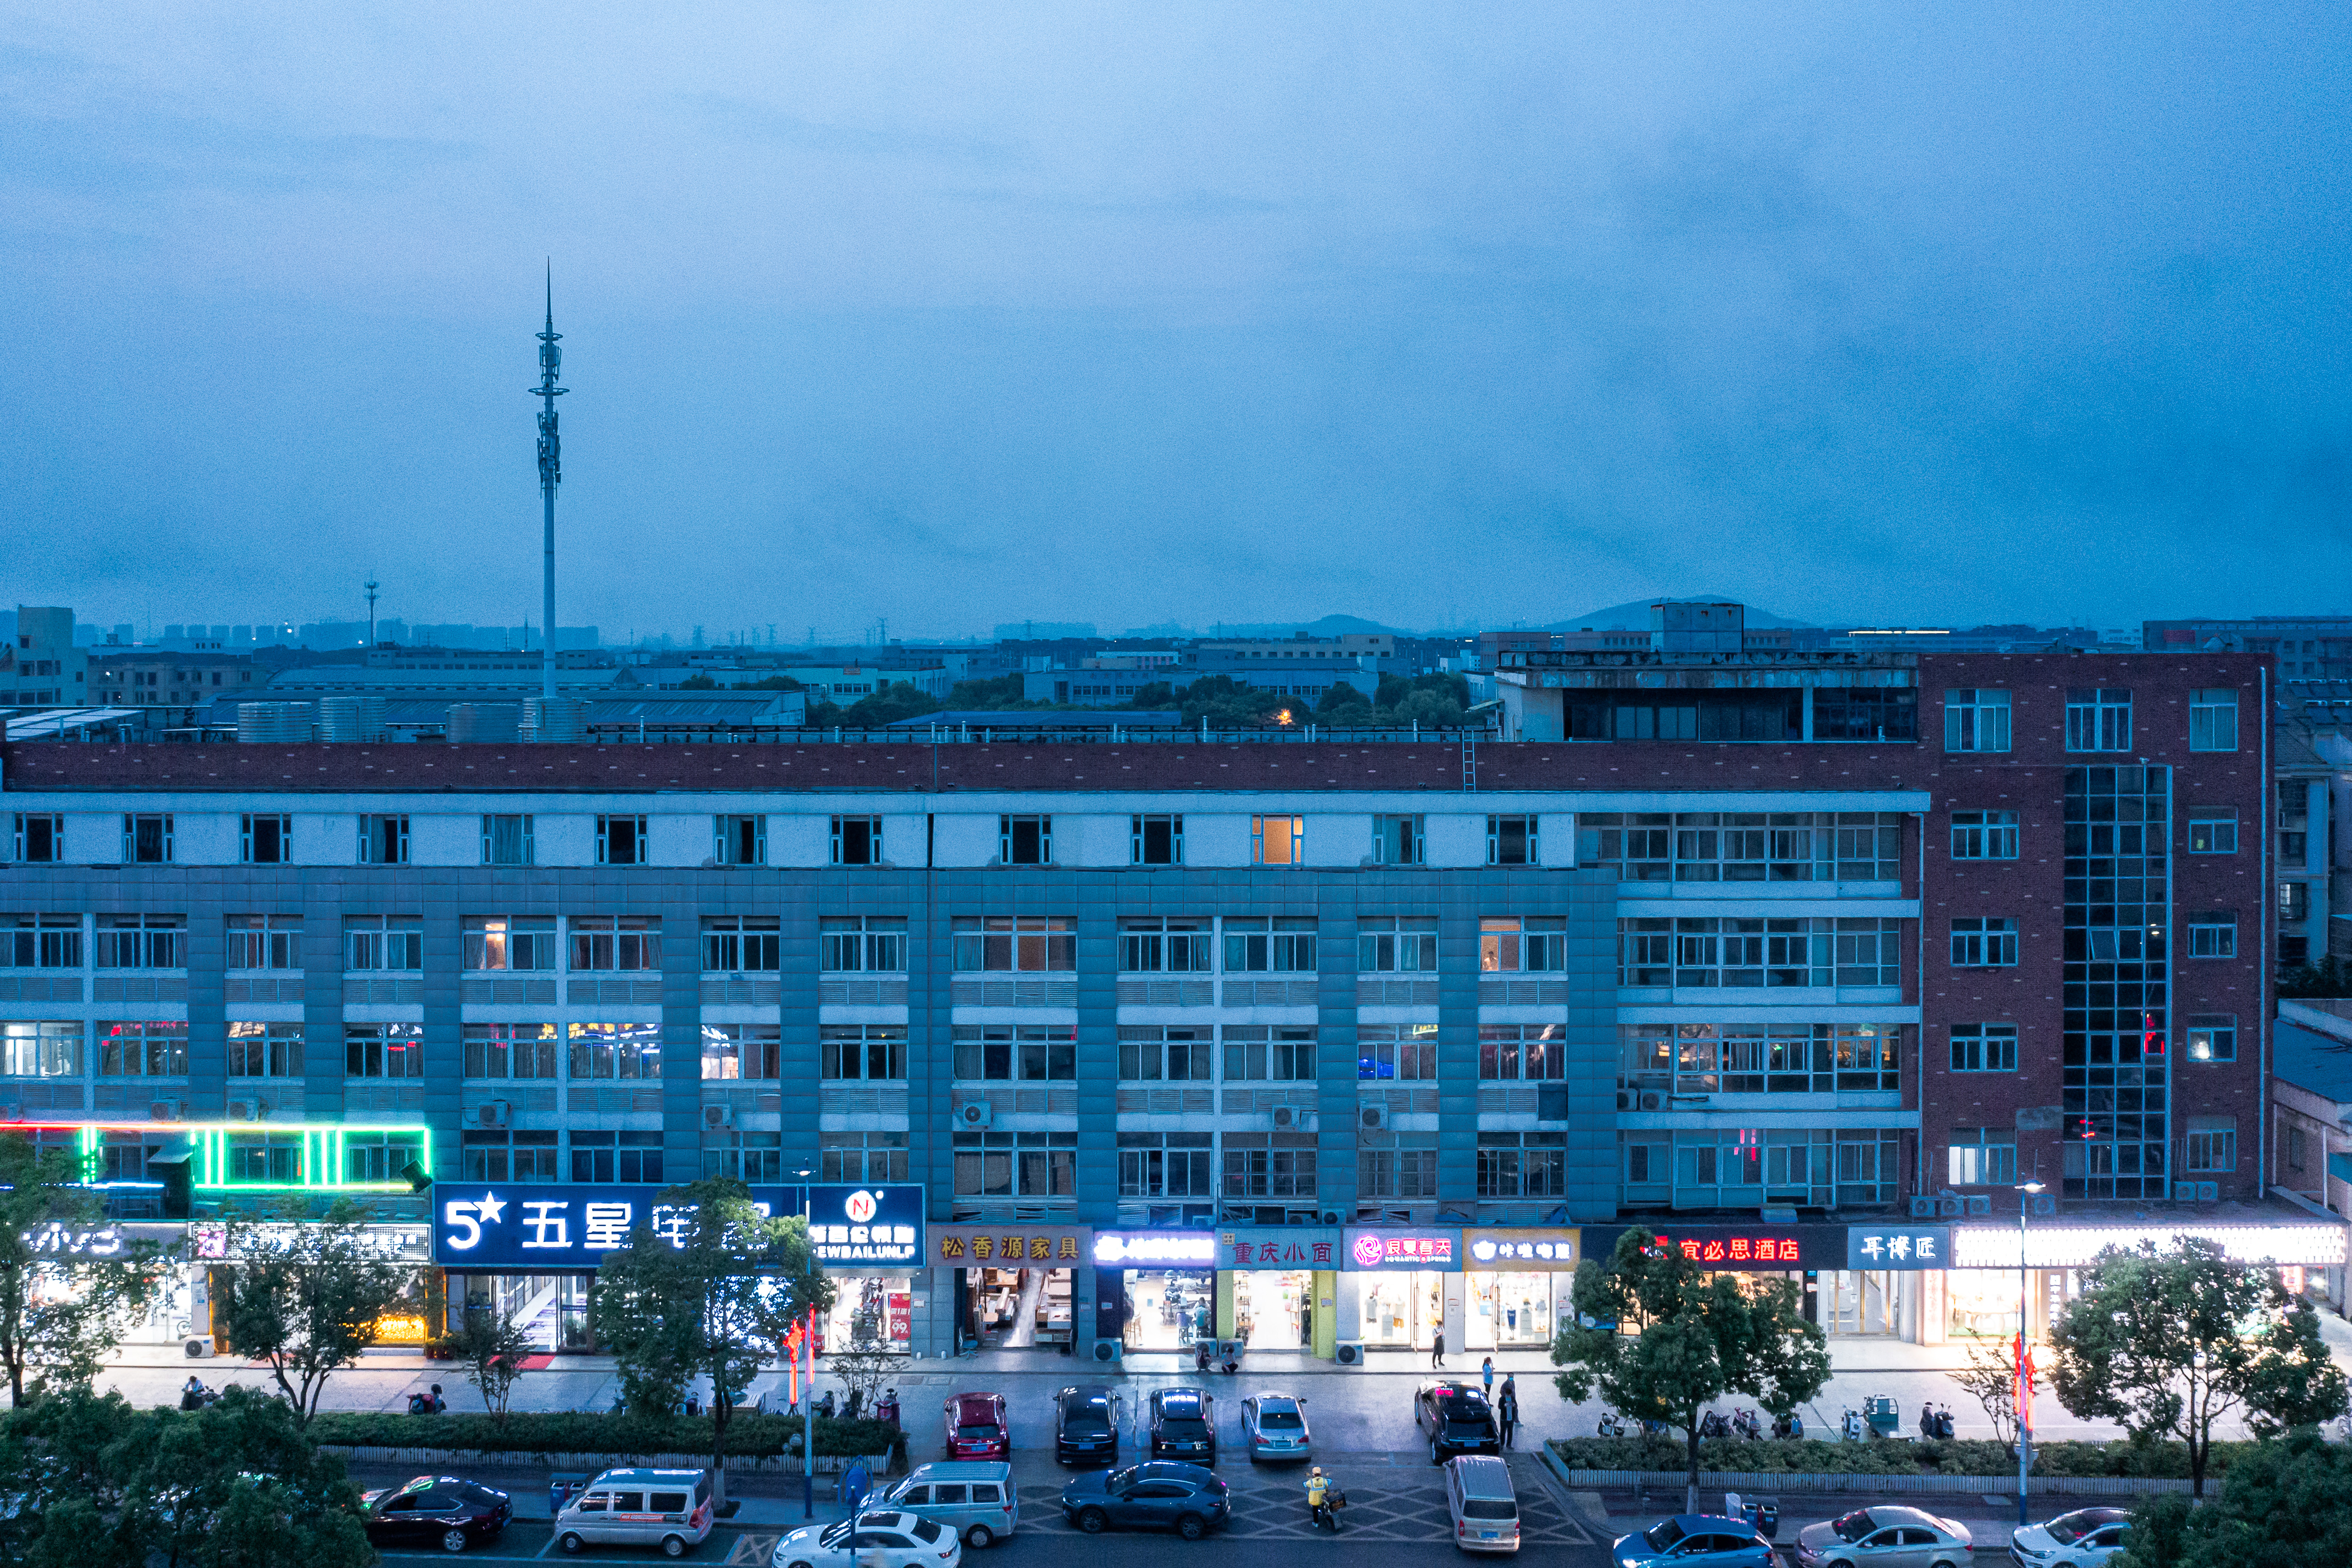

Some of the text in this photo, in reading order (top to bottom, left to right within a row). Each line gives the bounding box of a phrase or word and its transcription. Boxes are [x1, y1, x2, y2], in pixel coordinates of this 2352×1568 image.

[522, 1202, 771, 1250] 五星电
[813, 1246, 915, 1258] EWBAILUNLP
[942, 1236, 1079, 1259] 松香源家具
[1232, 1241, 1333, 1264] 重庆小面
[1680, 1239, 1799, 1261] 宜必思酒店
